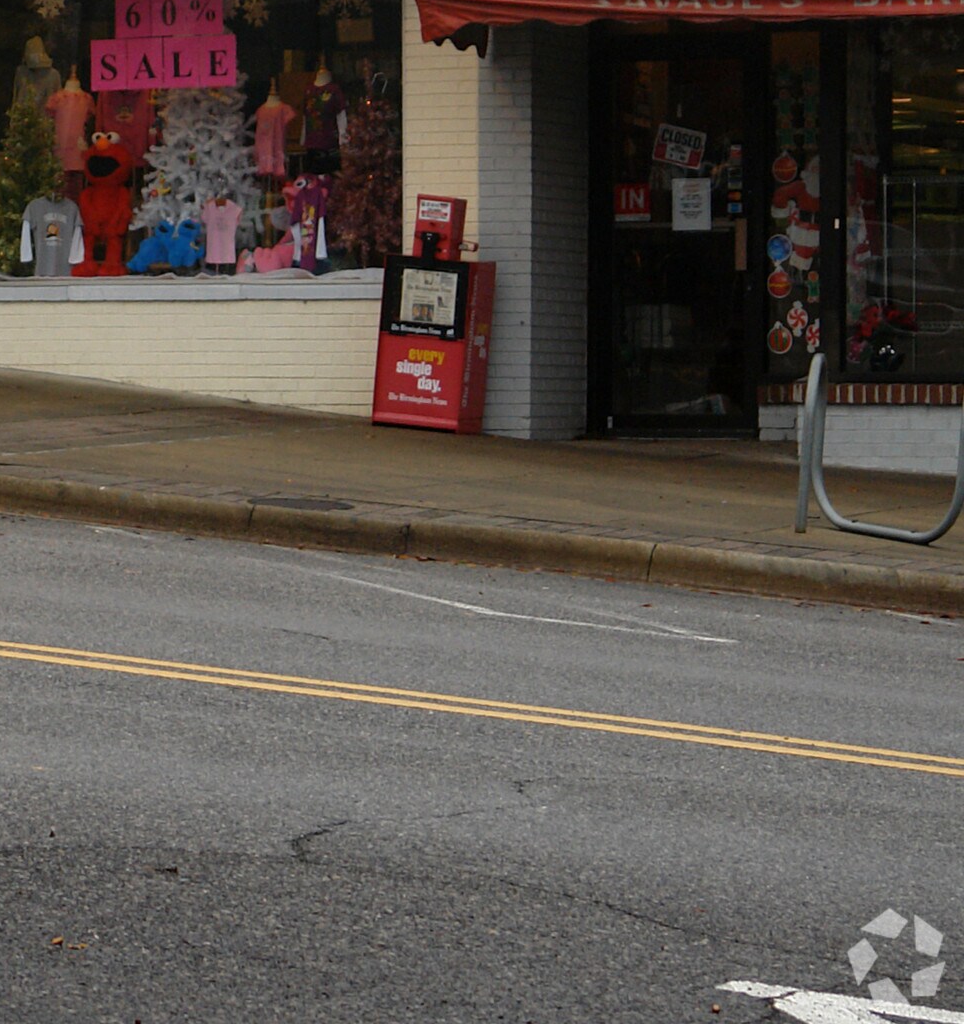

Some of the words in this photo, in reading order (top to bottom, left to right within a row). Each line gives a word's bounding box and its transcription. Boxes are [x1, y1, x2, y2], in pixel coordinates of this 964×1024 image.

[100, 49, 229, 82] SALE
[662, 128, 702, 150] CLOSED
[621, 188, 645, 210] IN
[408, 348, 445, 365] every
[396, 359, 432, 376] single
[417, 376, 442, 394] day.
